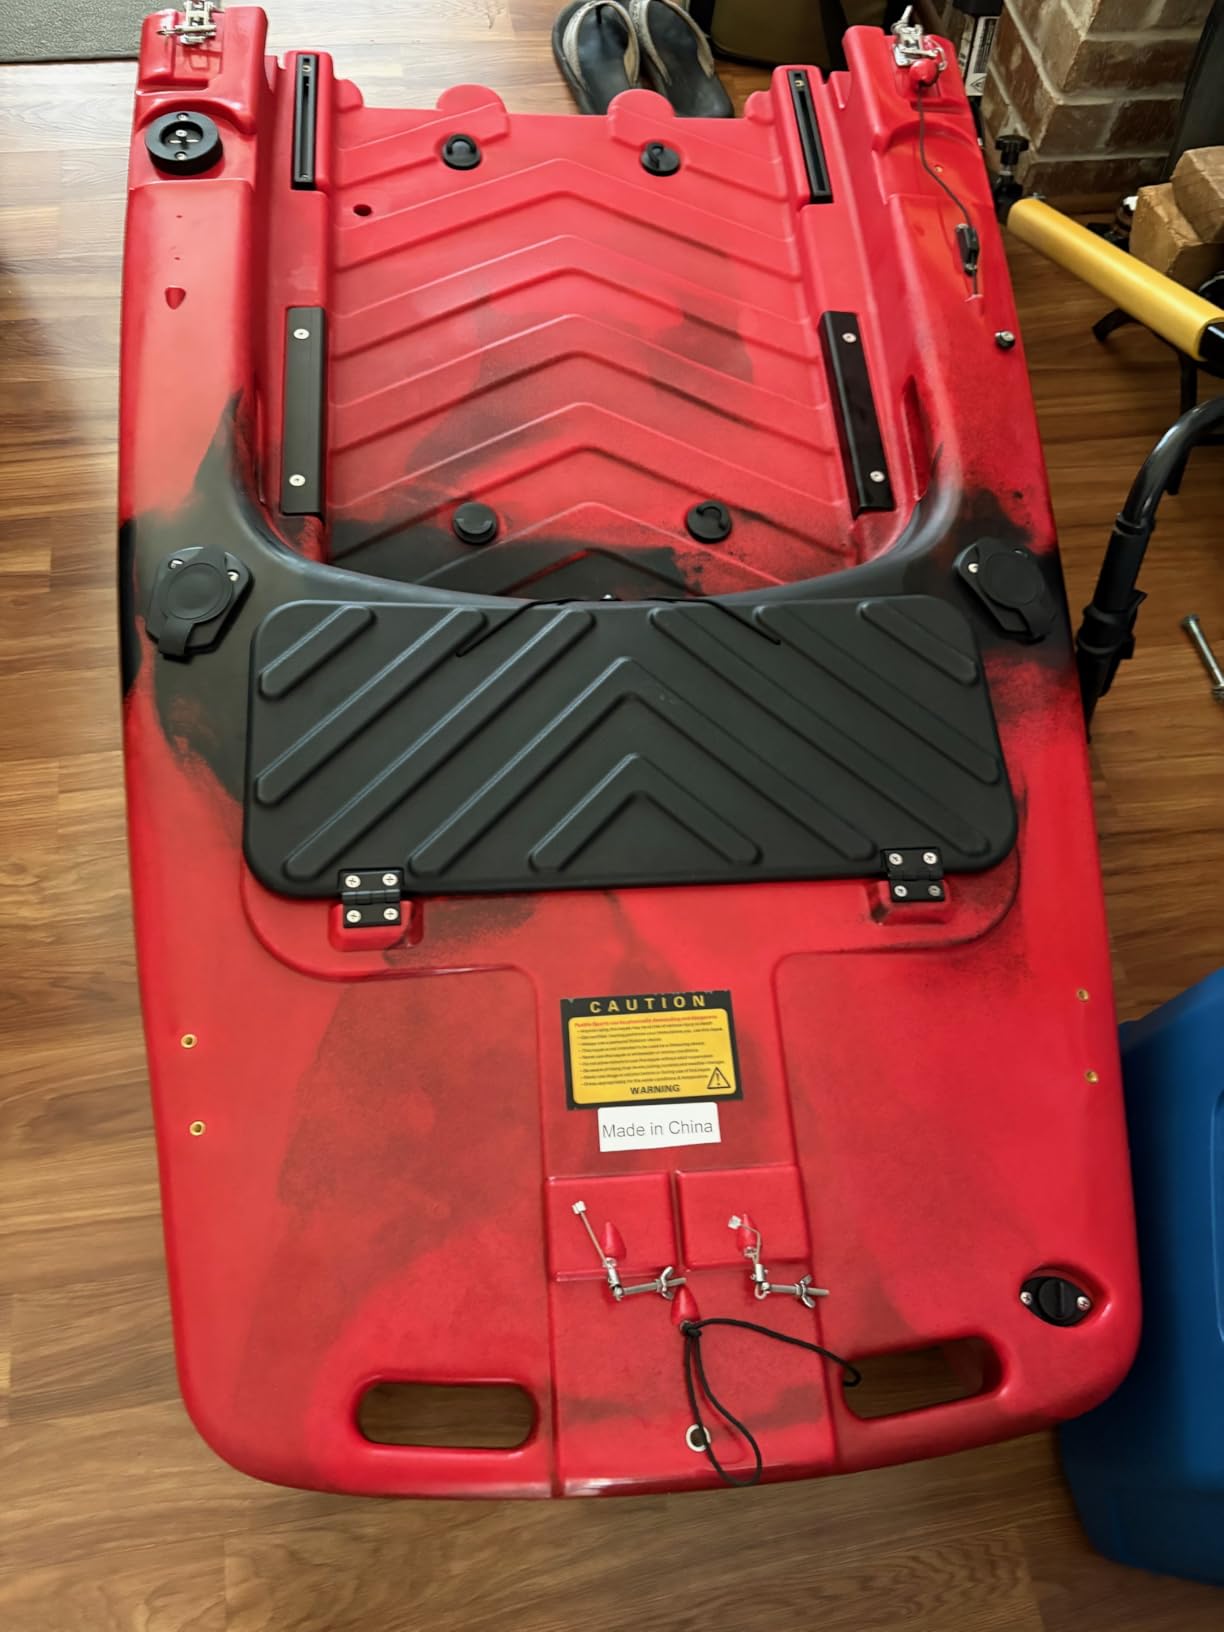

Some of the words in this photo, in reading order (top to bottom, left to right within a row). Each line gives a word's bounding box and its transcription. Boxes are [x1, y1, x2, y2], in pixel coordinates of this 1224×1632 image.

[589, 995, 706, 1014] CAUTION
[629, 1084, 681, 1096] WARNING
[602, 1123, 646, 1139] Made
[650, 1122, 664, 1136] in
[668, 1119, 713, 1135] China
